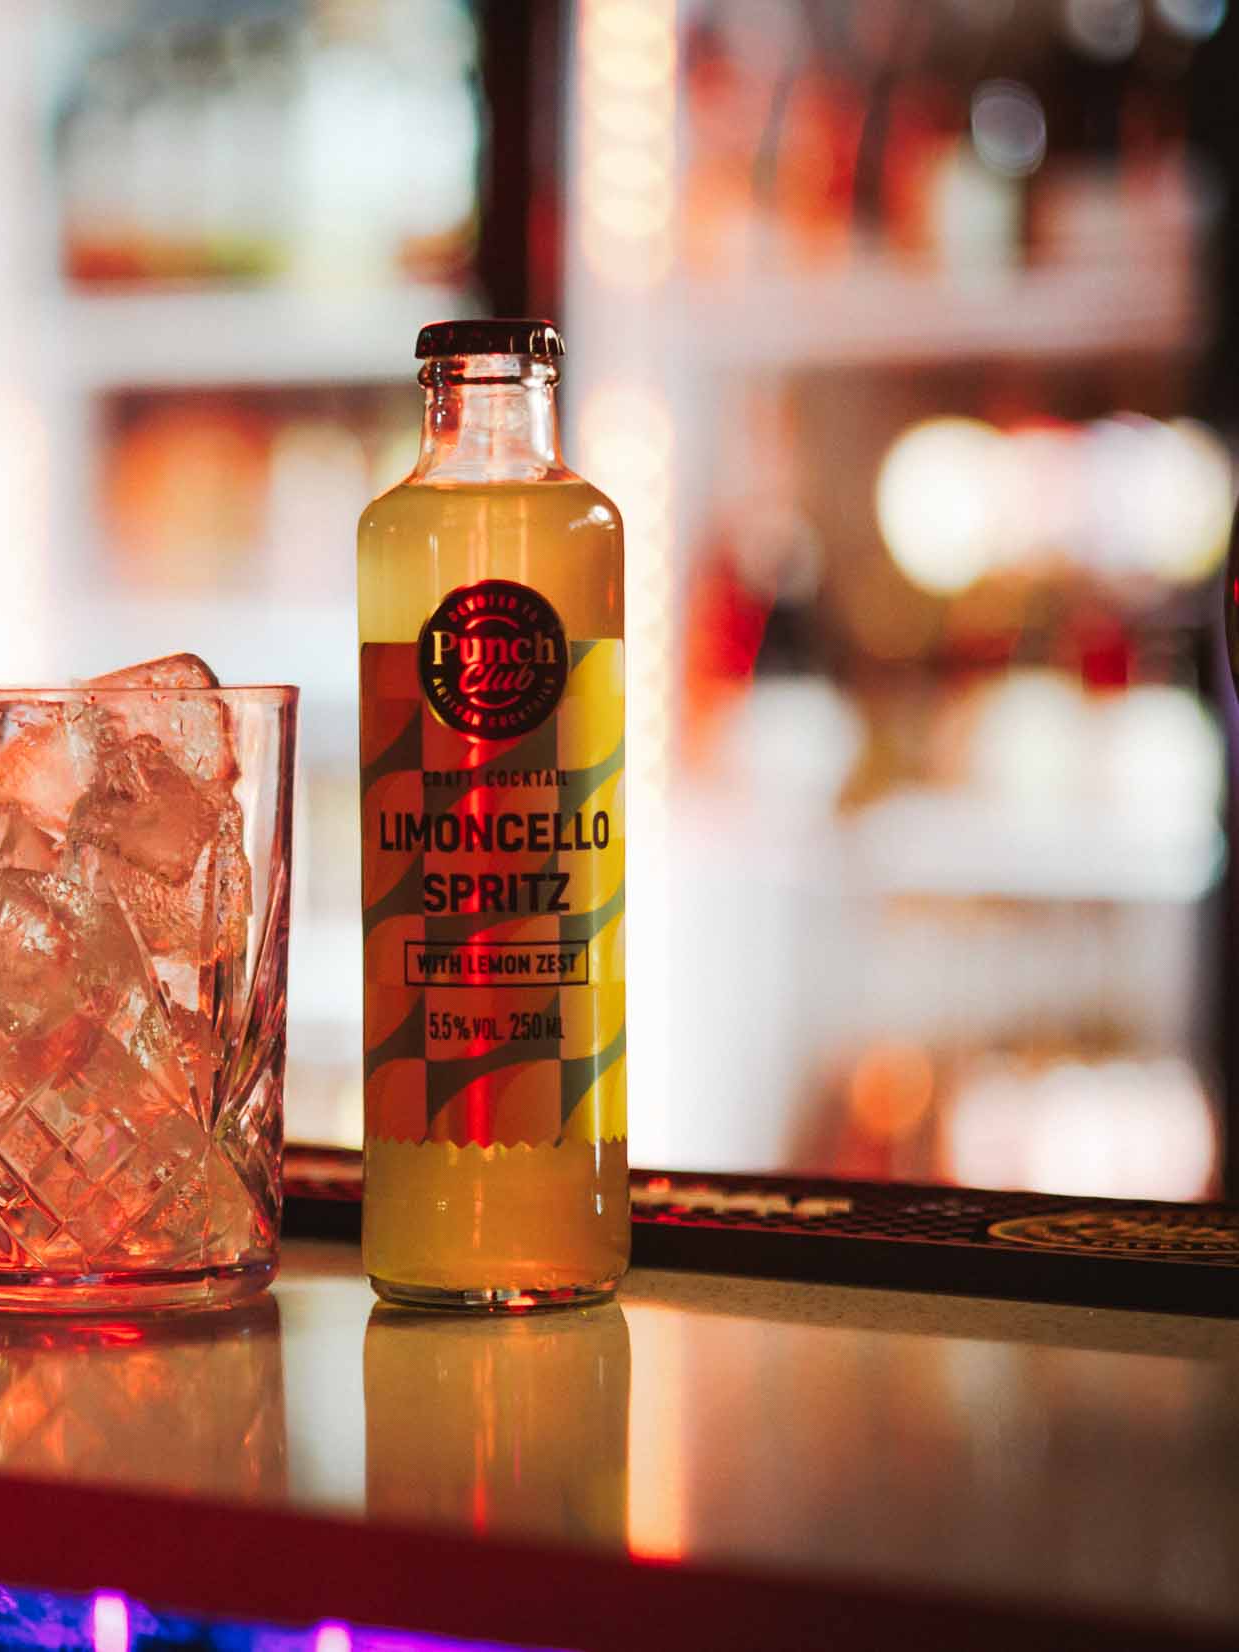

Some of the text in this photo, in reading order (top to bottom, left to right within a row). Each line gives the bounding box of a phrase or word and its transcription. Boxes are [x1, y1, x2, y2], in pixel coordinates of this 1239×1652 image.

[432, 631, 558, 665] Punch
[459, 663, 536, 693] Club
[423, 769, 569, 787] CRAFT COCKTAIL
[379, 810, 610, 852] LIMONCELLO
[423, 872, 571, 913] SPRITZ
[417, 953, 578, 974] WITH LEMON ZEST
[510, 1012, 541, 1040] 250
